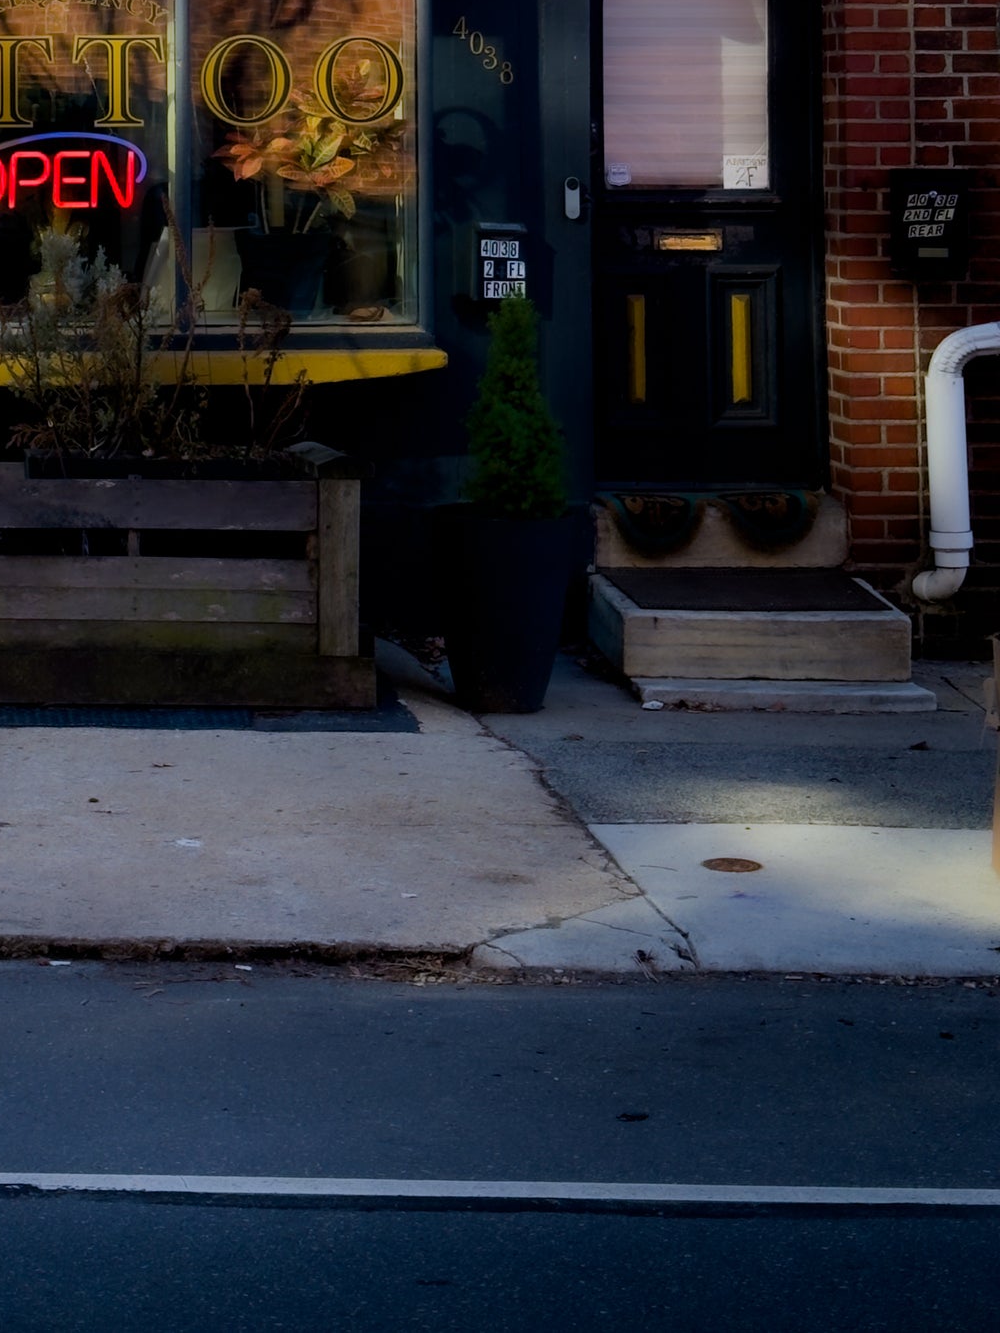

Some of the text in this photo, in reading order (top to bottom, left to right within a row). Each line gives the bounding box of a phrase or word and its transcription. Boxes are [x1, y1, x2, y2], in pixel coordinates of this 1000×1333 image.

[452, 15, 514, 85] 4038
[904, 209, 952, 221] 2ND FL
[910, 226, 943, 237] REAR
[482, 241, 517, 257] 4038
[485, 261, 523, 277] 2 FL
[485, 282, 524, 297] FRONT
